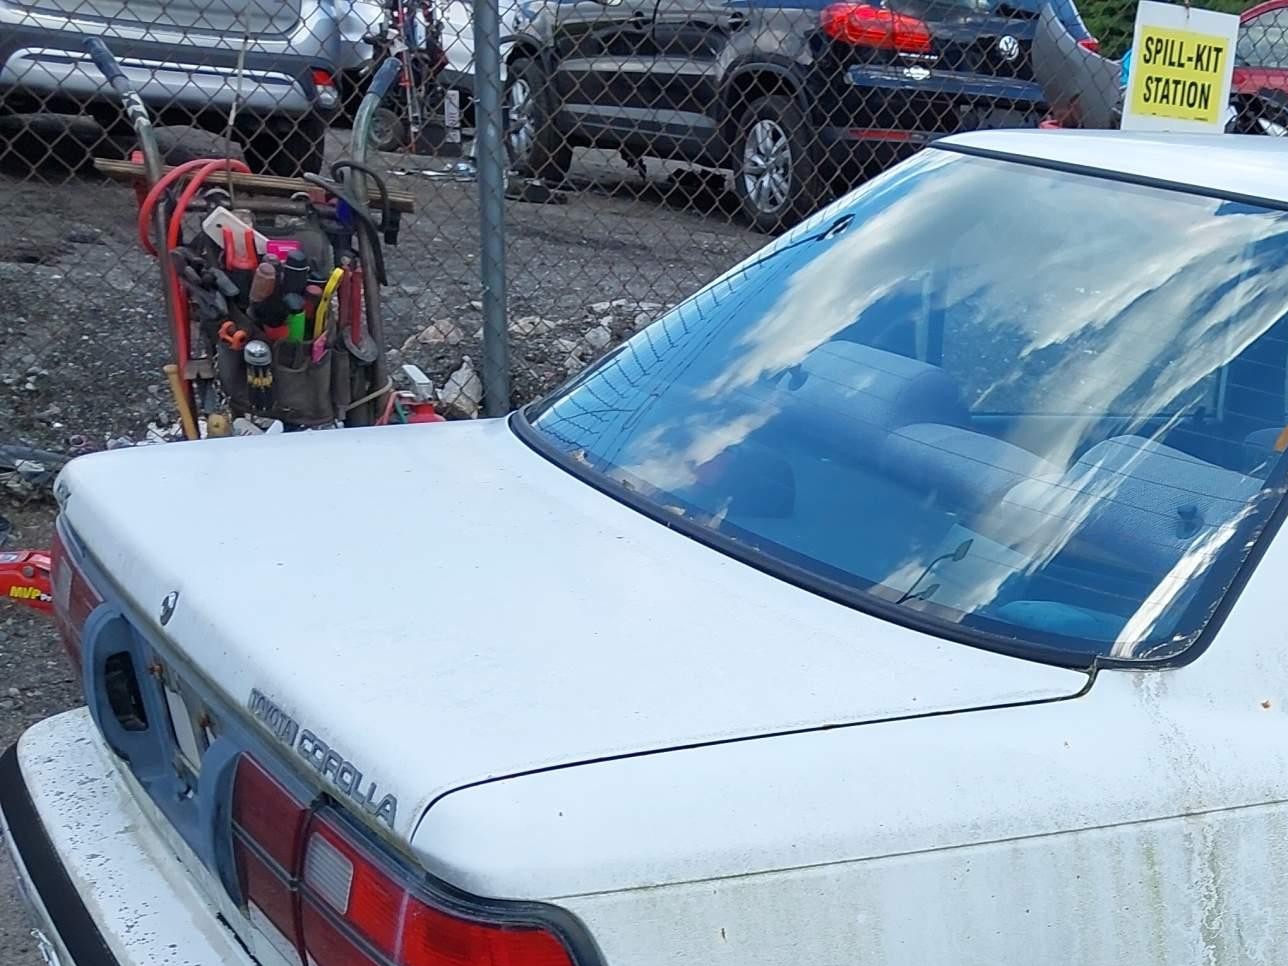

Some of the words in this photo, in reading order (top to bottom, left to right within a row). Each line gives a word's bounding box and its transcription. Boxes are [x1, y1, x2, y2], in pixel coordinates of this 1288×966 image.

[1143, 36, 1224, 73] SPILL-KIT
[1143, 75, 1212, 110] STATION
[9, 585, 41, 600] MVP
[248, 687, 299, 746] TOYOTA
[298, 728, 398, 832] COROLLA
